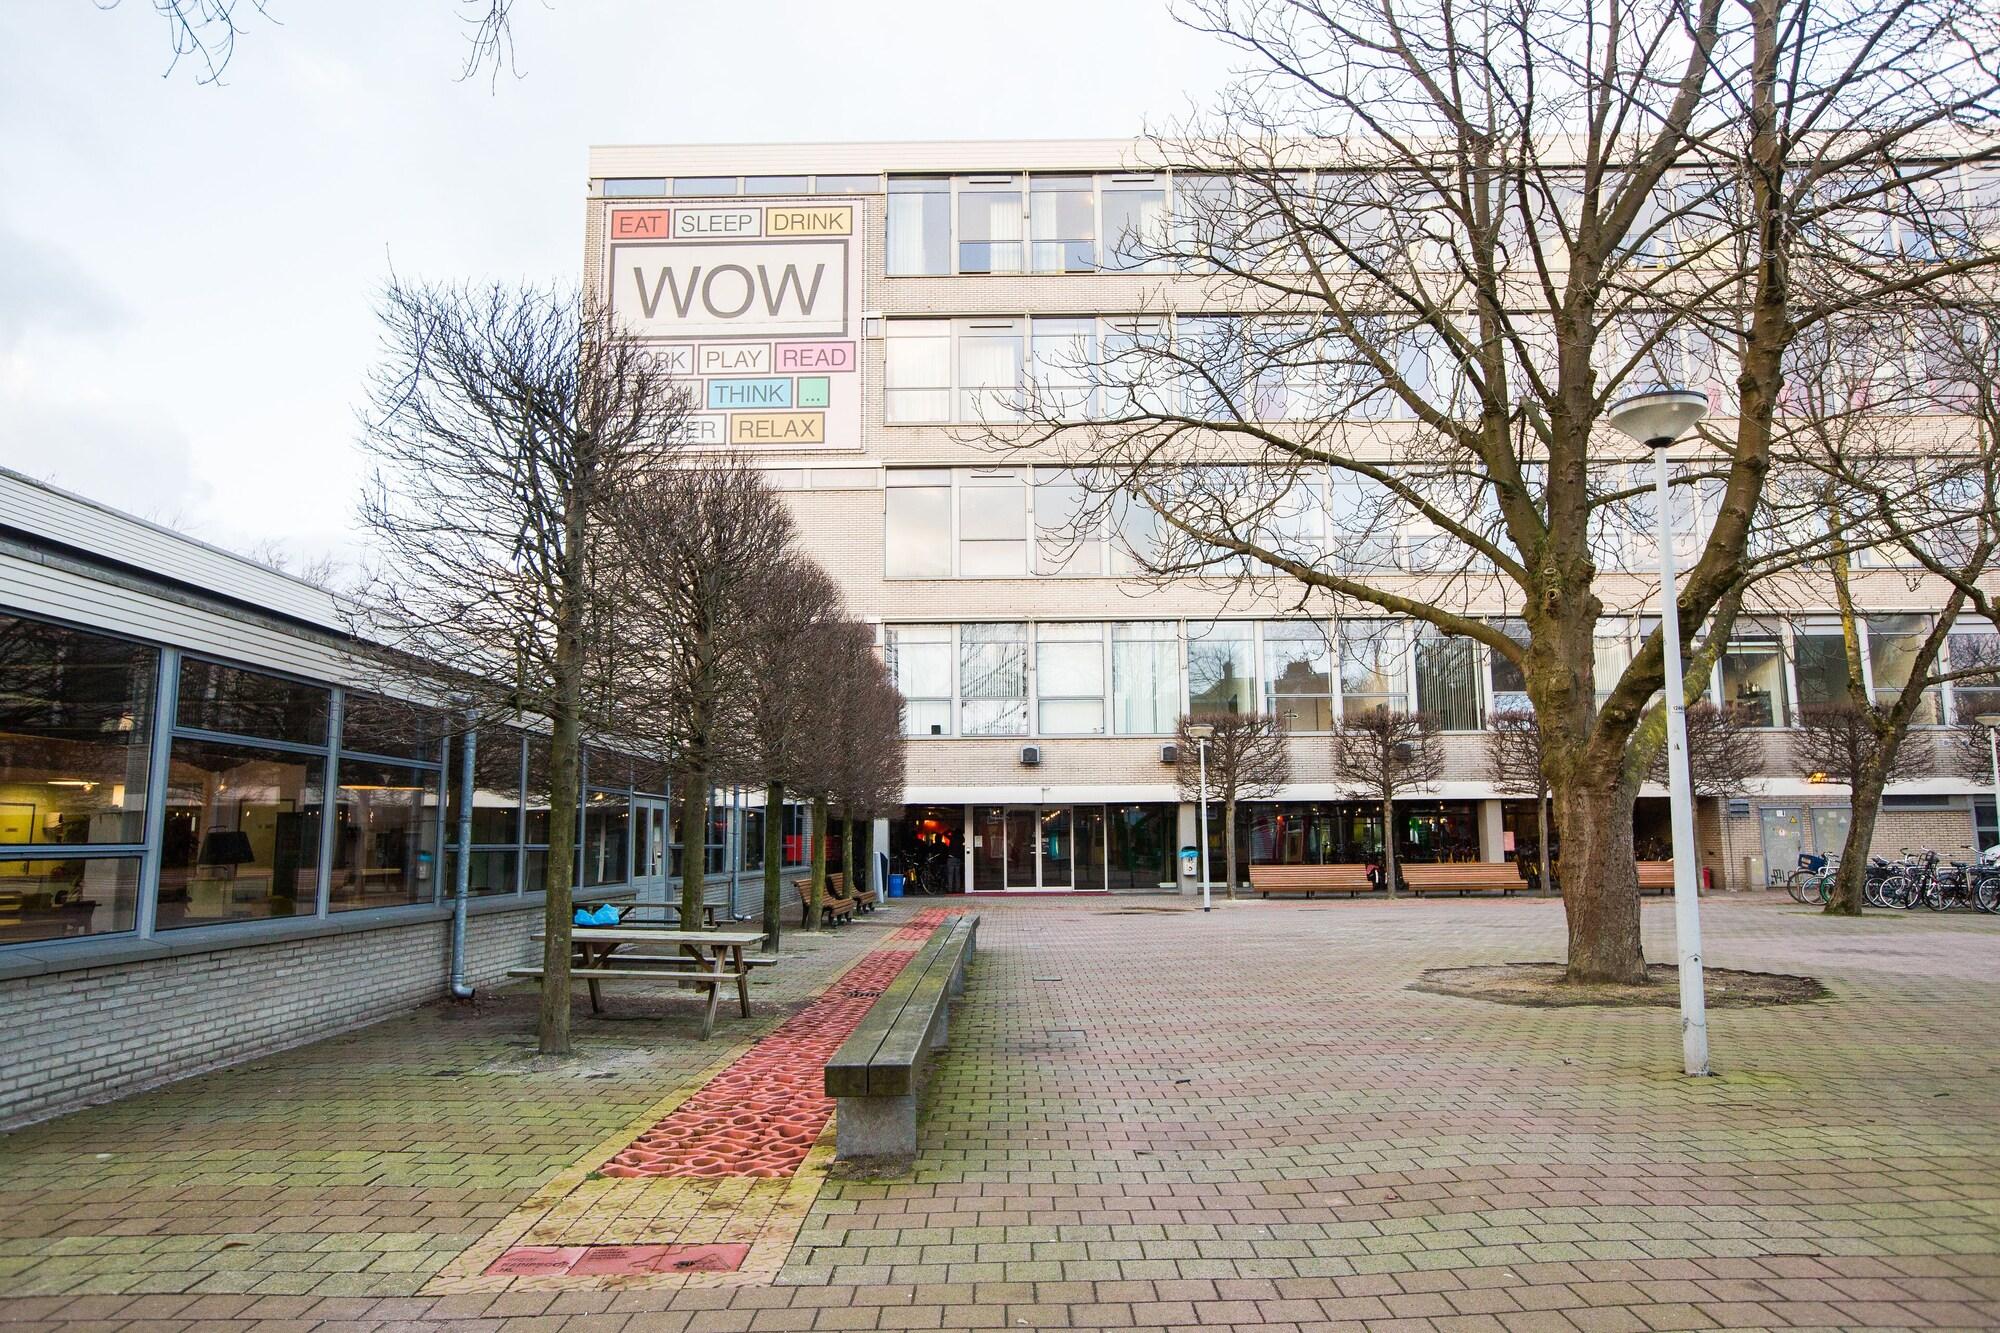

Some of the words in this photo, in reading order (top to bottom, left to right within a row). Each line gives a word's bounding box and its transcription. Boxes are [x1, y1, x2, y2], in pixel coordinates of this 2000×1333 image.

[619, 216, 661, 233] EAT
[681, 215, 753, 232] SLEEP
[774, 213, 843, 230] DRINK
[633, 264, 825, 318] WOW
[628, 351, 685, 368] ORK
[706, 350, 762, 367] PLAY
[783, 349, 846, 366] READ
[715, 384, 784, 402] THINK
[739, 420, 815, 437] RELAX
